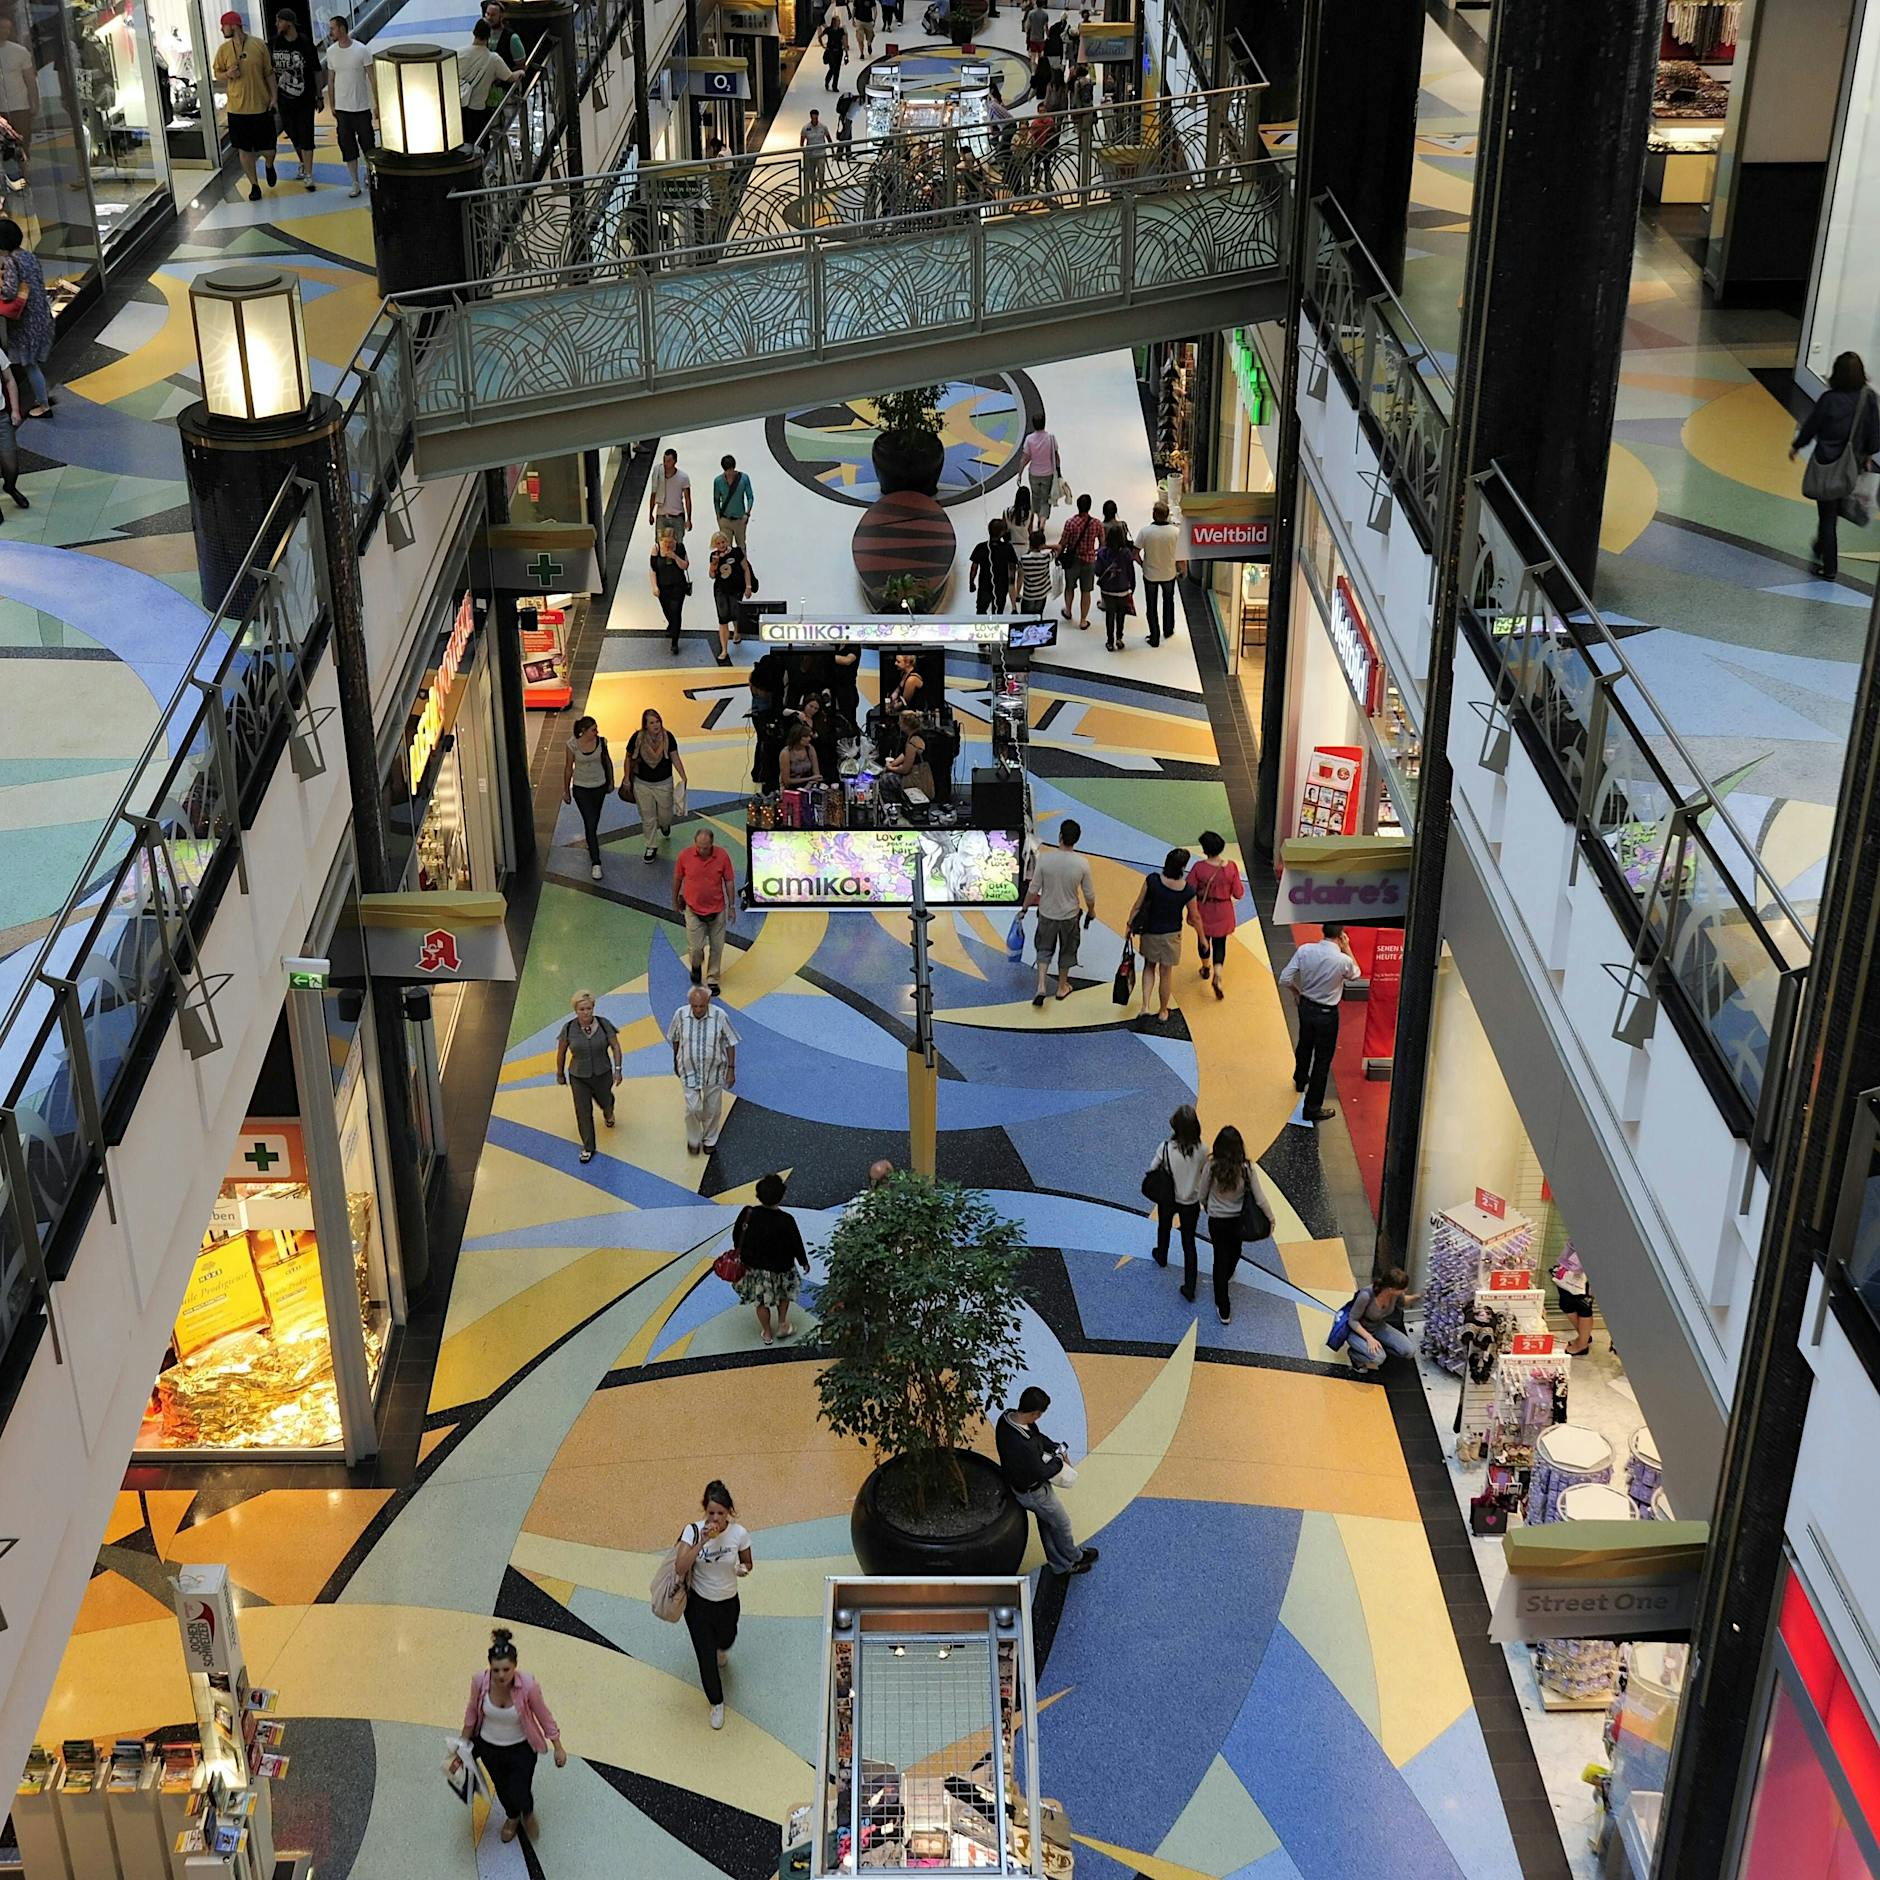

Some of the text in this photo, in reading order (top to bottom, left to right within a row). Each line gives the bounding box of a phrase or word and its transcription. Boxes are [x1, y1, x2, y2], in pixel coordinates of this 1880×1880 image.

[1193, 526, 1268, 543] Weltbild
[1330, 588, 1369, 706] Weltbild
[1288, 878, 1399, 905] claire's
[210, 1210, 236, 1221] ben
[1526, 1593, 1670, 1613] Street One
[187, 1622, 202, 1653] JOCHEN
[198, 1622, 215, 1667] SCHWEIZER
